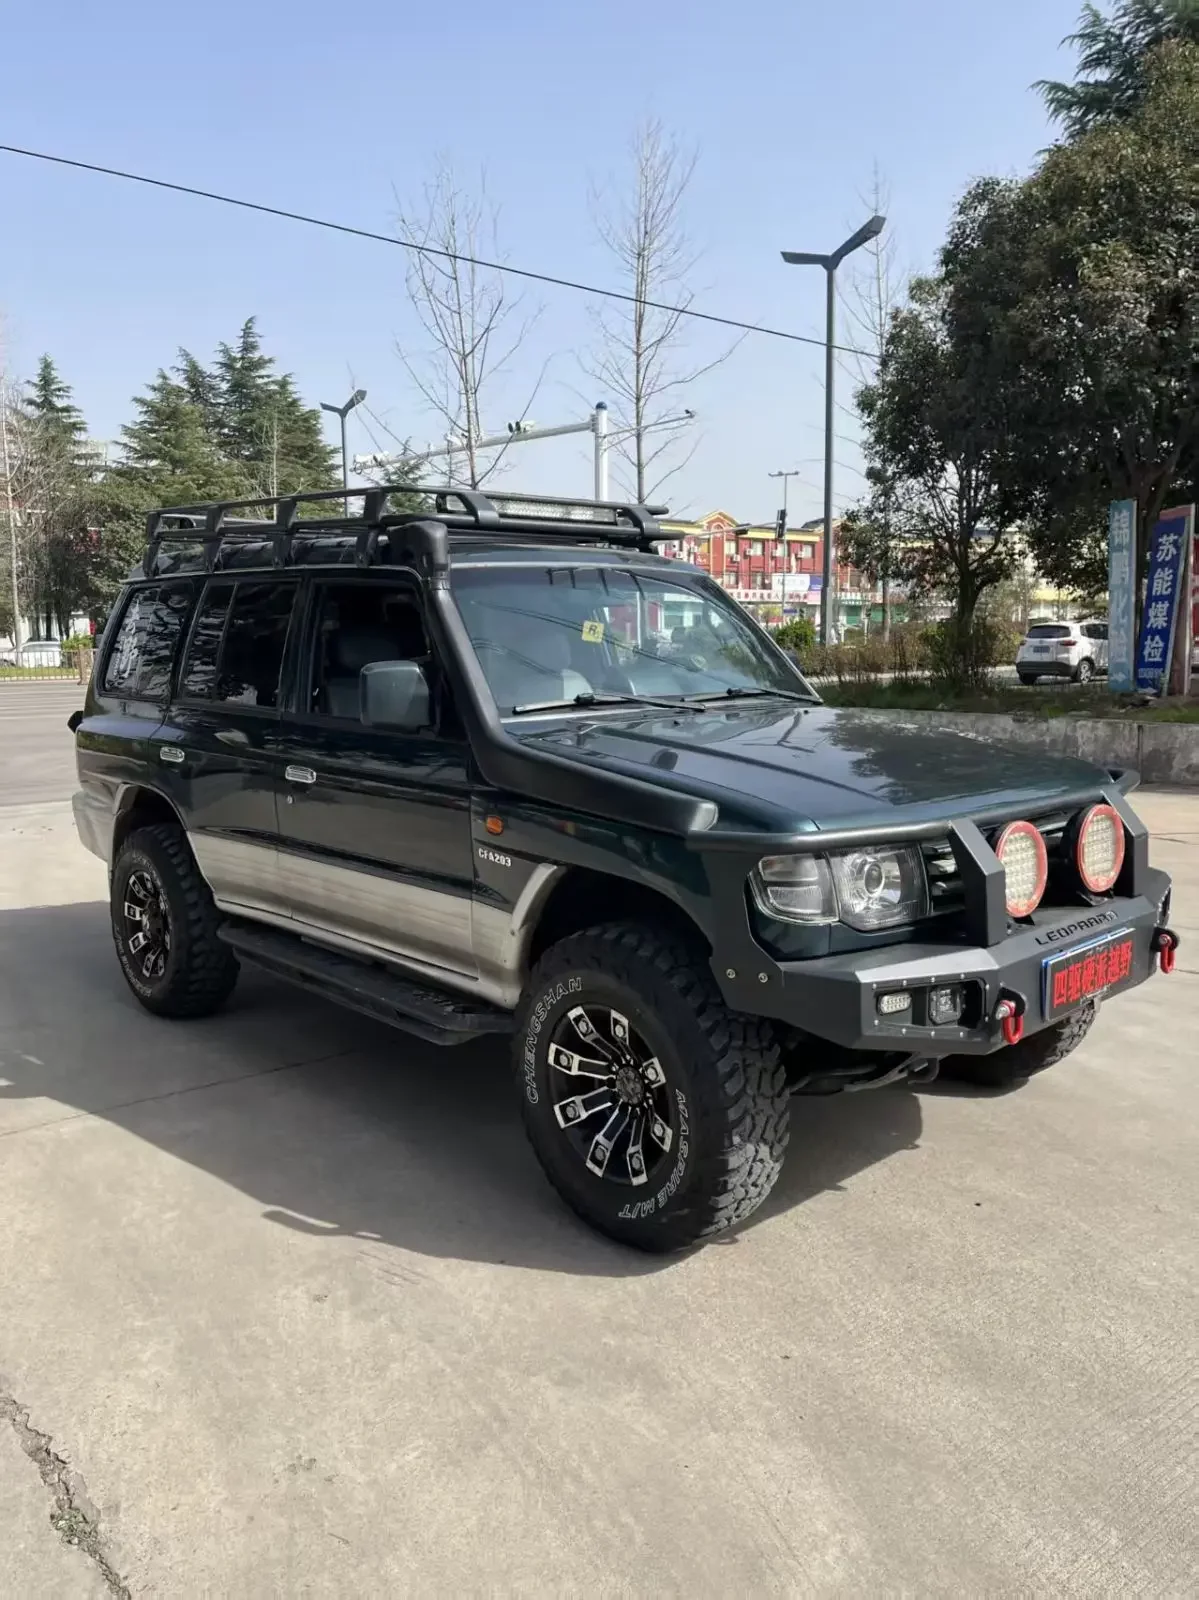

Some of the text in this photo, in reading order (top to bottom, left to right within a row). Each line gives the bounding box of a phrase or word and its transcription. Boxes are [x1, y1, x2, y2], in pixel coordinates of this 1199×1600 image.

[1143, 533, 1179, 663] 苏能煤检
[478, 847, 512, 867] CFA203
[523, 977, 582, 1104] CHENGSHAN
